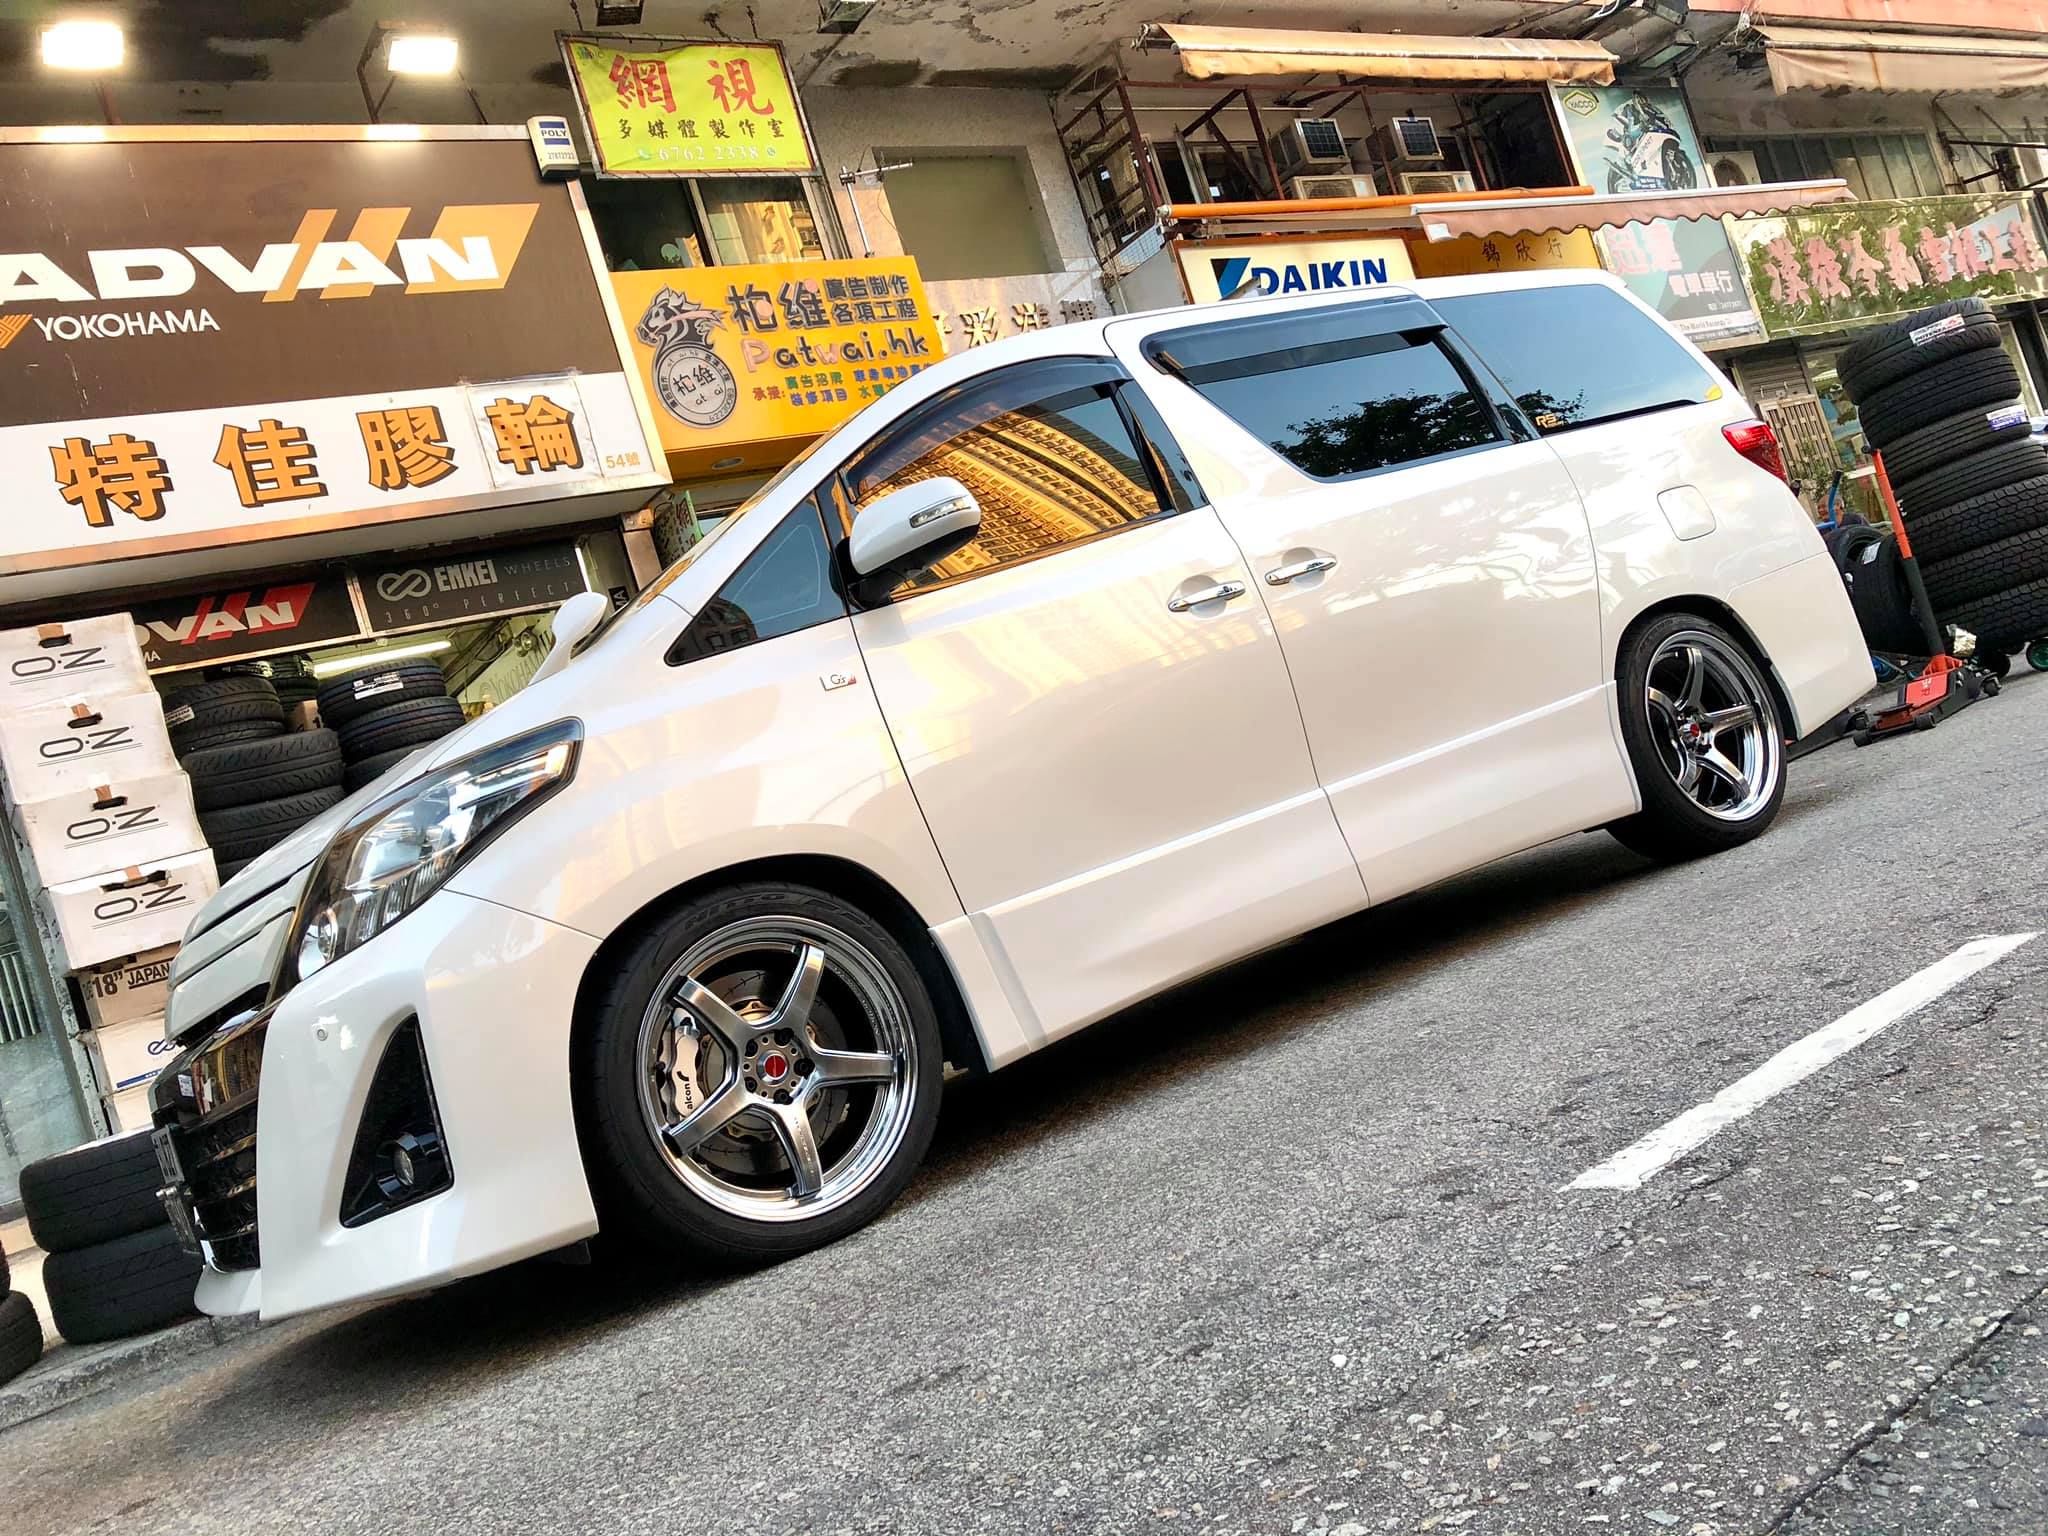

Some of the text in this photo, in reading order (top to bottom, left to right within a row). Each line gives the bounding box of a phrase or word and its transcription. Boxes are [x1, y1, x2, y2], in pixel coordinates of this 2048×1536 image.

[608, 54, 775, 115] 網視
[541, 129, 567, 137] POLY
[618, 117, 785, 140] 多媒體製作室
[658, 145, 706, 161] 6762
[0, 235, 500, 302] ADVAN
[1251, 257, 1388, 296] DAIKIN
[823, 274, 910, 300] 廣告制作
[33, 307, 221, 342] YOKOHAMA
[832, 298, 919, 324] 各項工程
[741, 327, 929, 373] Patwai.hk
[49, 394, 586, 527] 特佳膠輪
[606, 451, 640, 469] 54號
[433, 556, 571, 592] ENKEI WHEELS
[127, 962, 171, 987] JAPAN
[685, 1083, 693, 1110] alcon
